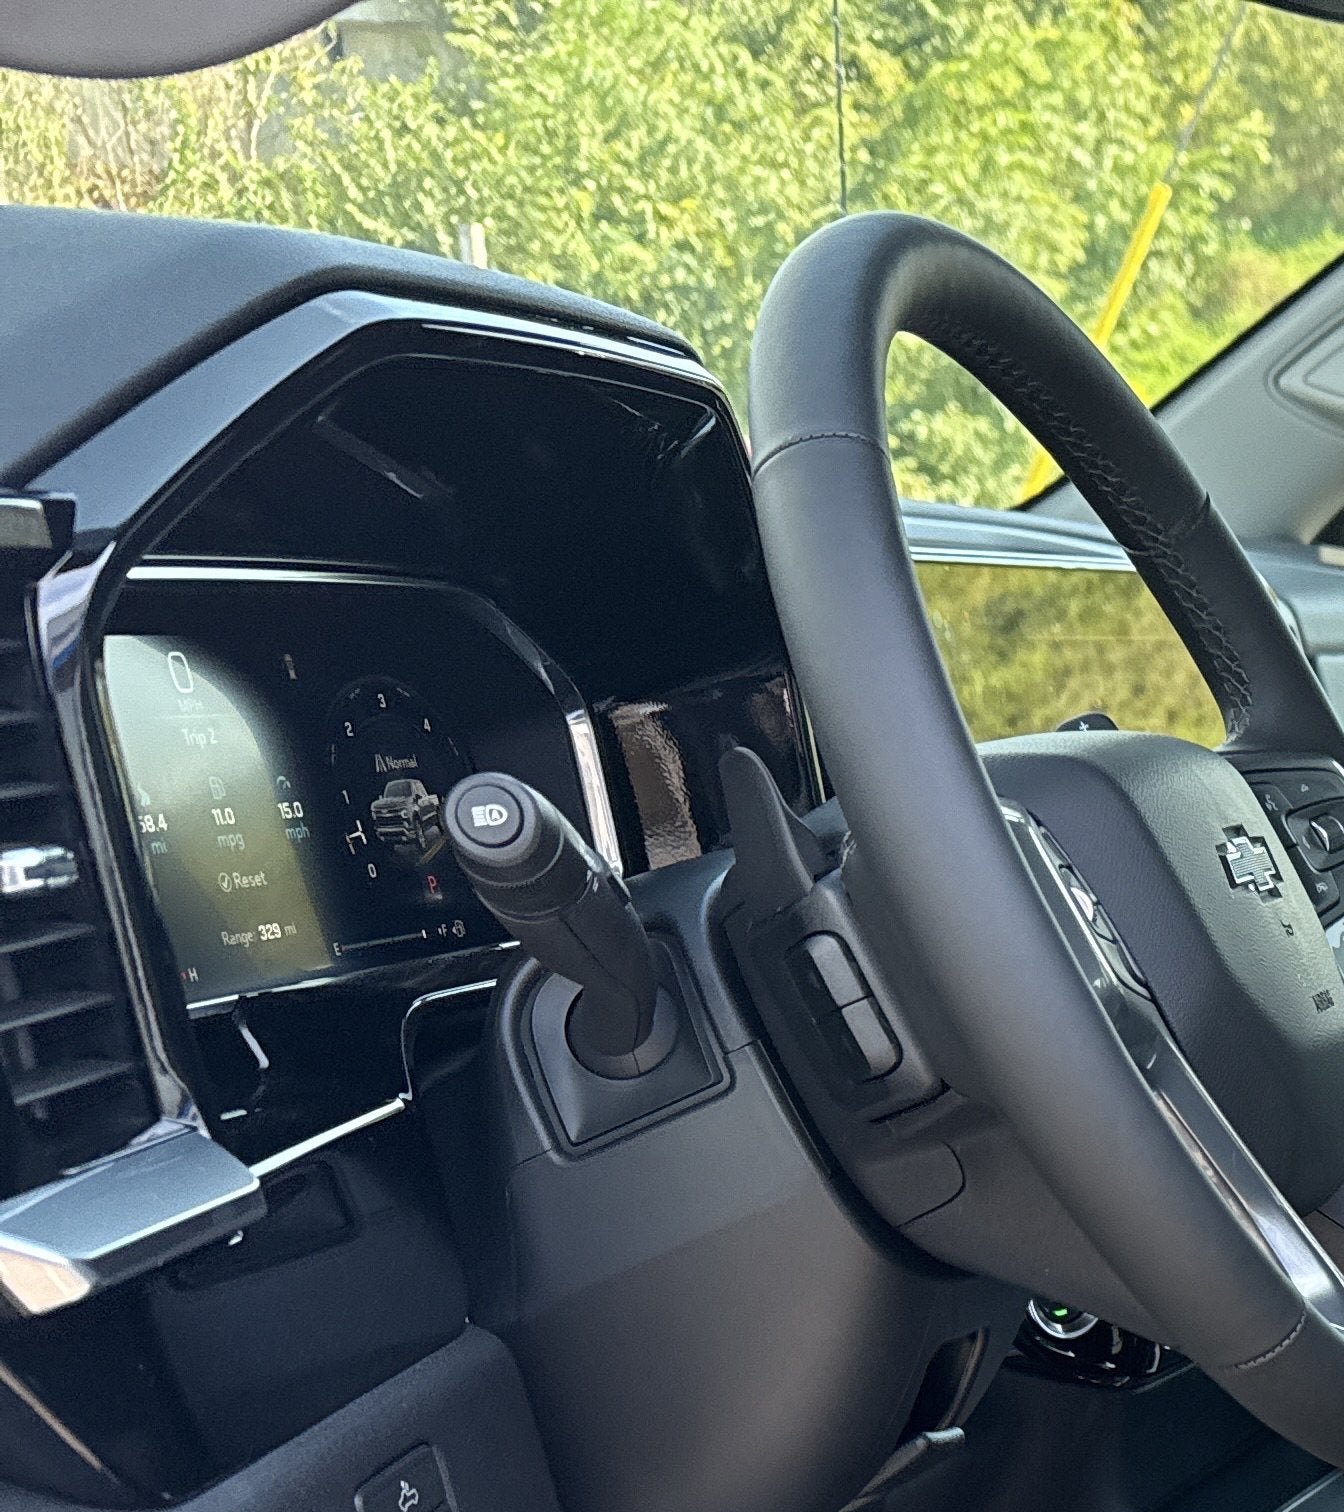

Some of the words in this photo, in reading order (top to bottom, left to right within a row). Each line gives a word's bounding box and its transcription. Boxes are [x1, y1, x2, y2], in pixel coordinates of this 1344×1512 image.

[376, 693, 387, 708] 3
[344, 721, 354, 737] 2
[423, 717, 432, 733] 4
[181, 728, 207, 749] Trip
[208, 727, 218, 745] 2
[385, 753, 419, 770] Normal
[211, 807, 236, 826] 11.0
[277, 801, 304, 820] 15.0
[151, 840, 168, 855] mi
[217, 832, 246, 852] mpg
[284, 822, 310, 844] mph
[232, 870, 268, 889] Reset
[426, 875, 438, 894] P
[258, 922, 282, 941] 329
[284, 922, 298, 937] mi
[333, 942, 342, 957] E
[187, 967, 199, 982] H
